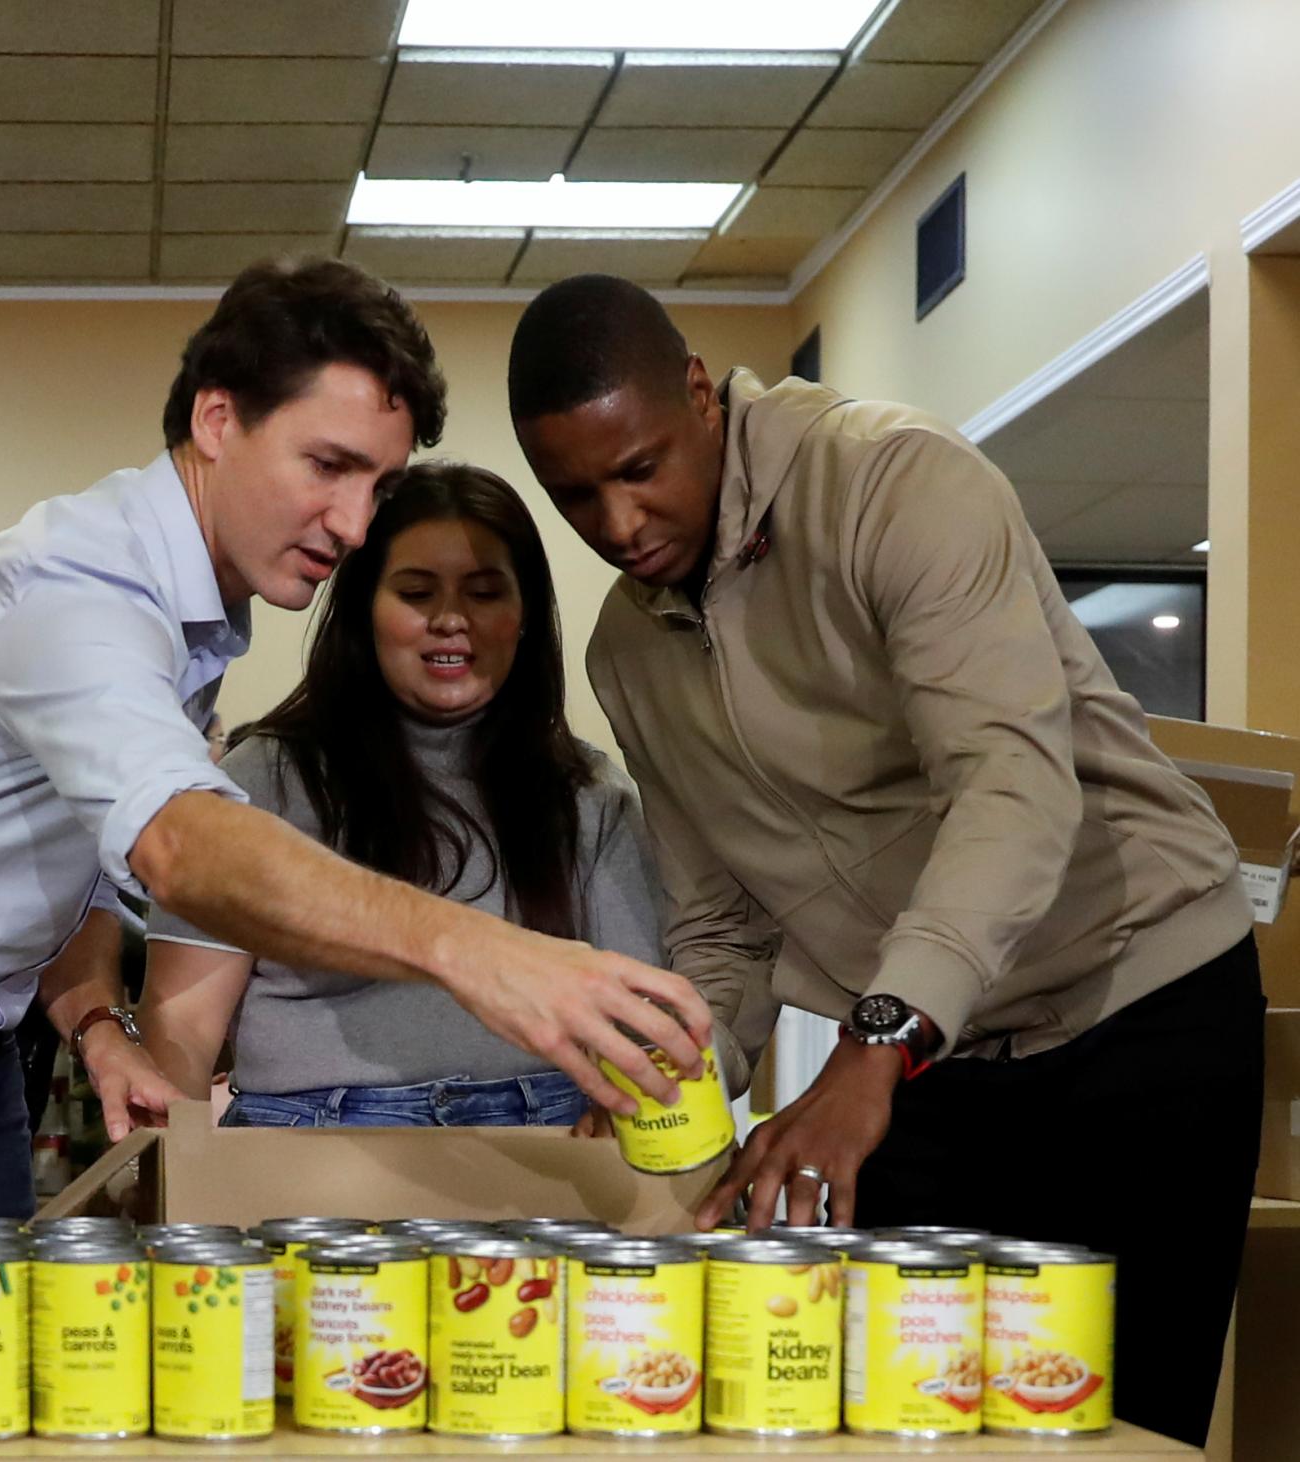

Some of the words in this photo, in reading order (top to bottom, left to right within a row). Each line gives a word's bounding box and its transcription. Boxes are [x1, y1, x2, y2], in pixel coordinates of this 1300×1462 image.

[631, 1111, 690, 1131] lentils
[585, 1290, 667, 1306] chickpeas
[901, 1314, 936, 1328] pois
[61, 1326, 99, 1338] peas
[104, 1324, 115, 1337] &
[182, 1325, 191, 1338] &
[901, 1332, 962, 1344] chiches
[61, 1339, 117, 1351] carrots
[767, 1340, 833, 1364] kidney
[451, 1362, 504, 1378] mixed
[509, 1361, 550, 1378] bean
[767, 1360, 830, 1381] beans
[451, 1378, 497, 1394] salad
